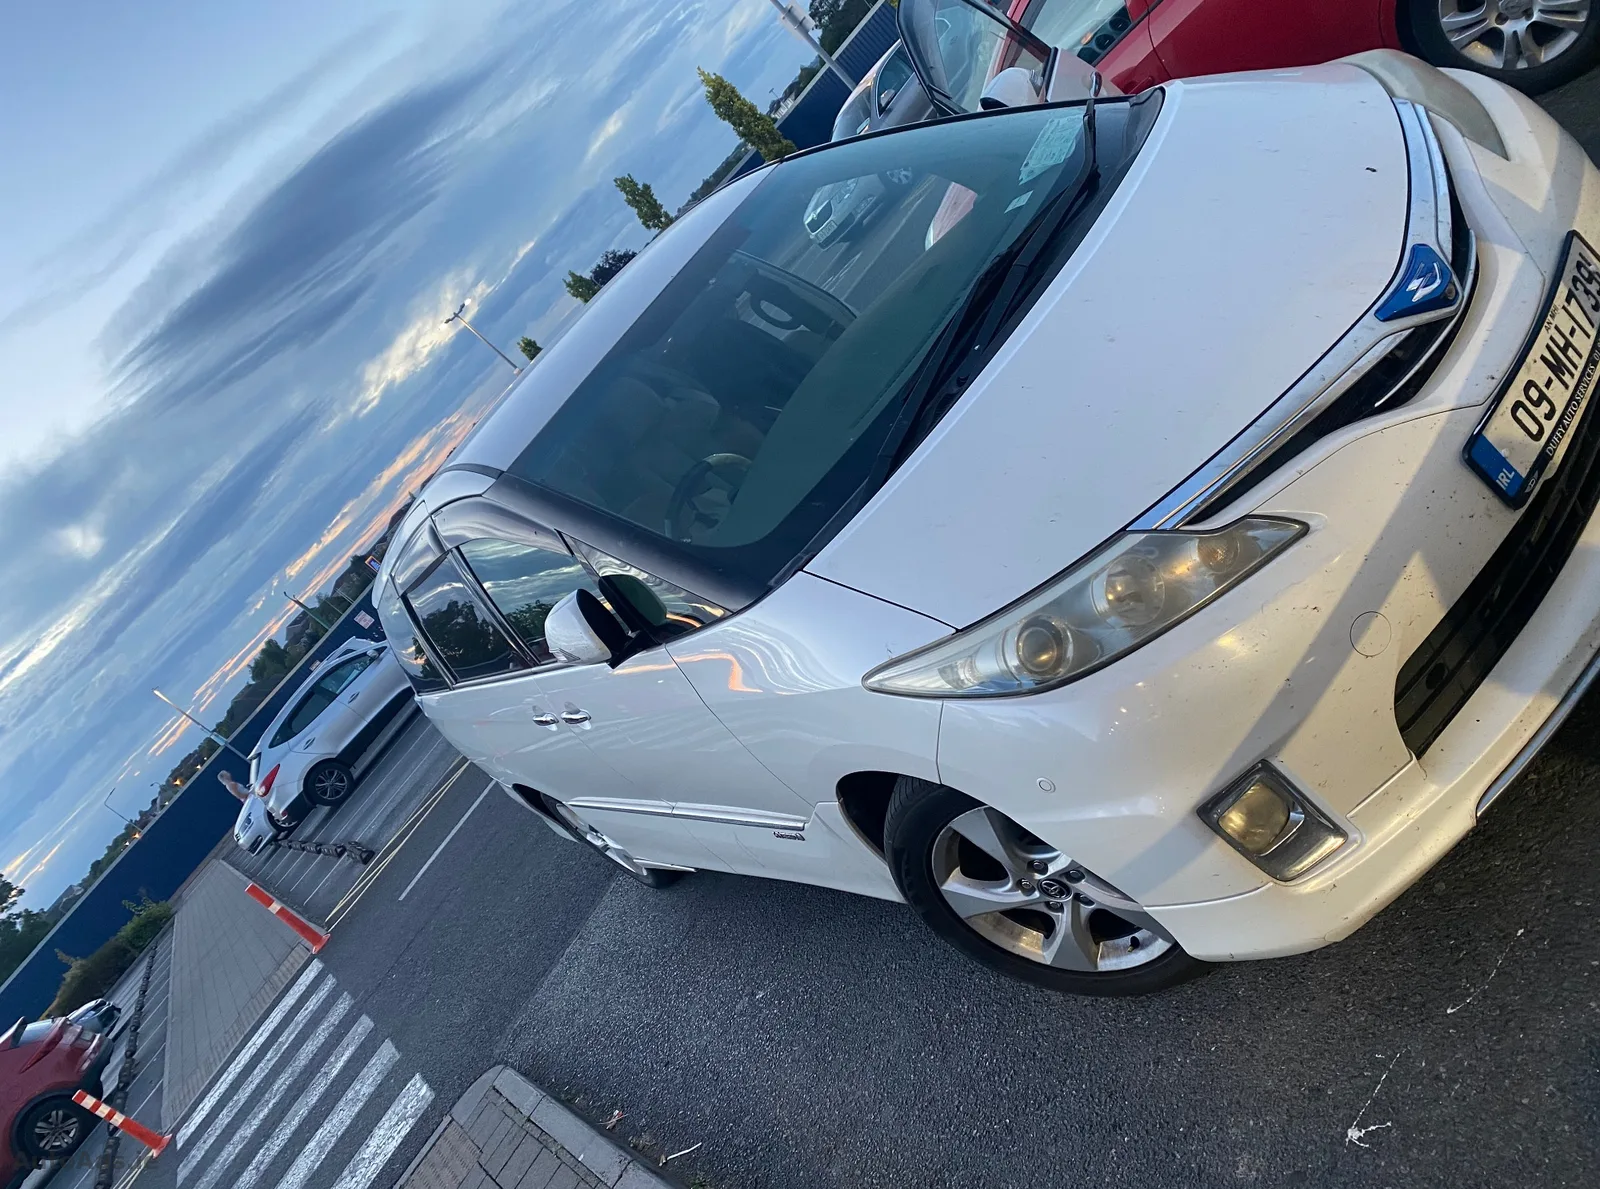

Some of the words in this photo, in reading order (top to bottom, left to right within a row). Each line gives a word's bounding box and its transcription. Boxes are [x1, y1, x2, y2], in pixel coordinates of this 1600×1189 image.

[1546, 424, 1566, 456] DUFFY
[1562, 401, 1579, 428] AUTO
[1575, 363, 1596, 402] SERVICES
[1496, 467, 1516, 491] IRL
